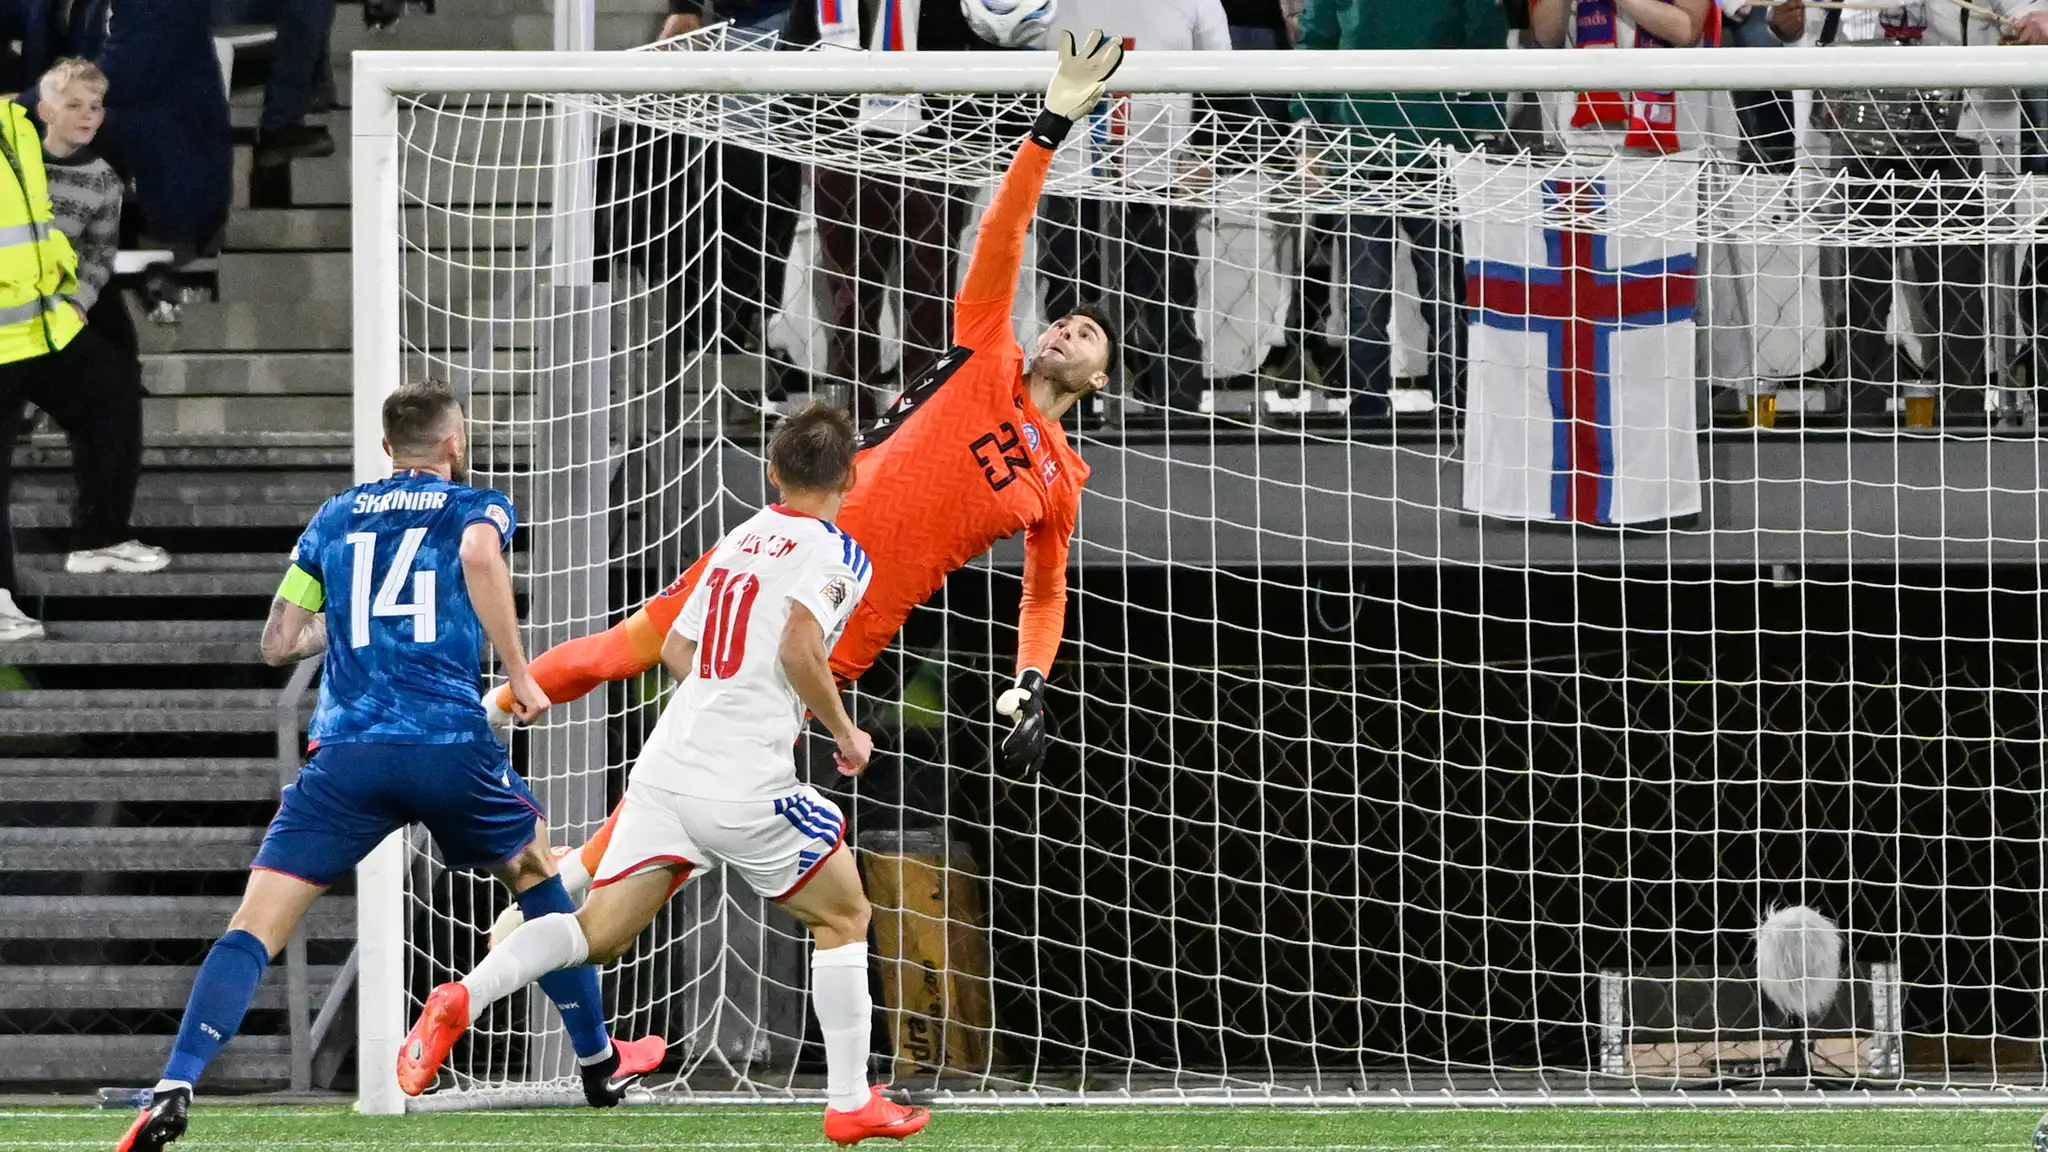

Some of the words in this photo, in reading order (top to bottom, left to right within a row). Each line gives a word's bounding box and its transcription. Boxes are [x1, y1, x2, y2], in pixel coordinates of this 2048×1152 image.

[969, 421, 1032, 491] 23
[346, 527, 436, 649] 14
[700, 567, 760, 680] 10
[200, 1022, 222, 1041] SVK
